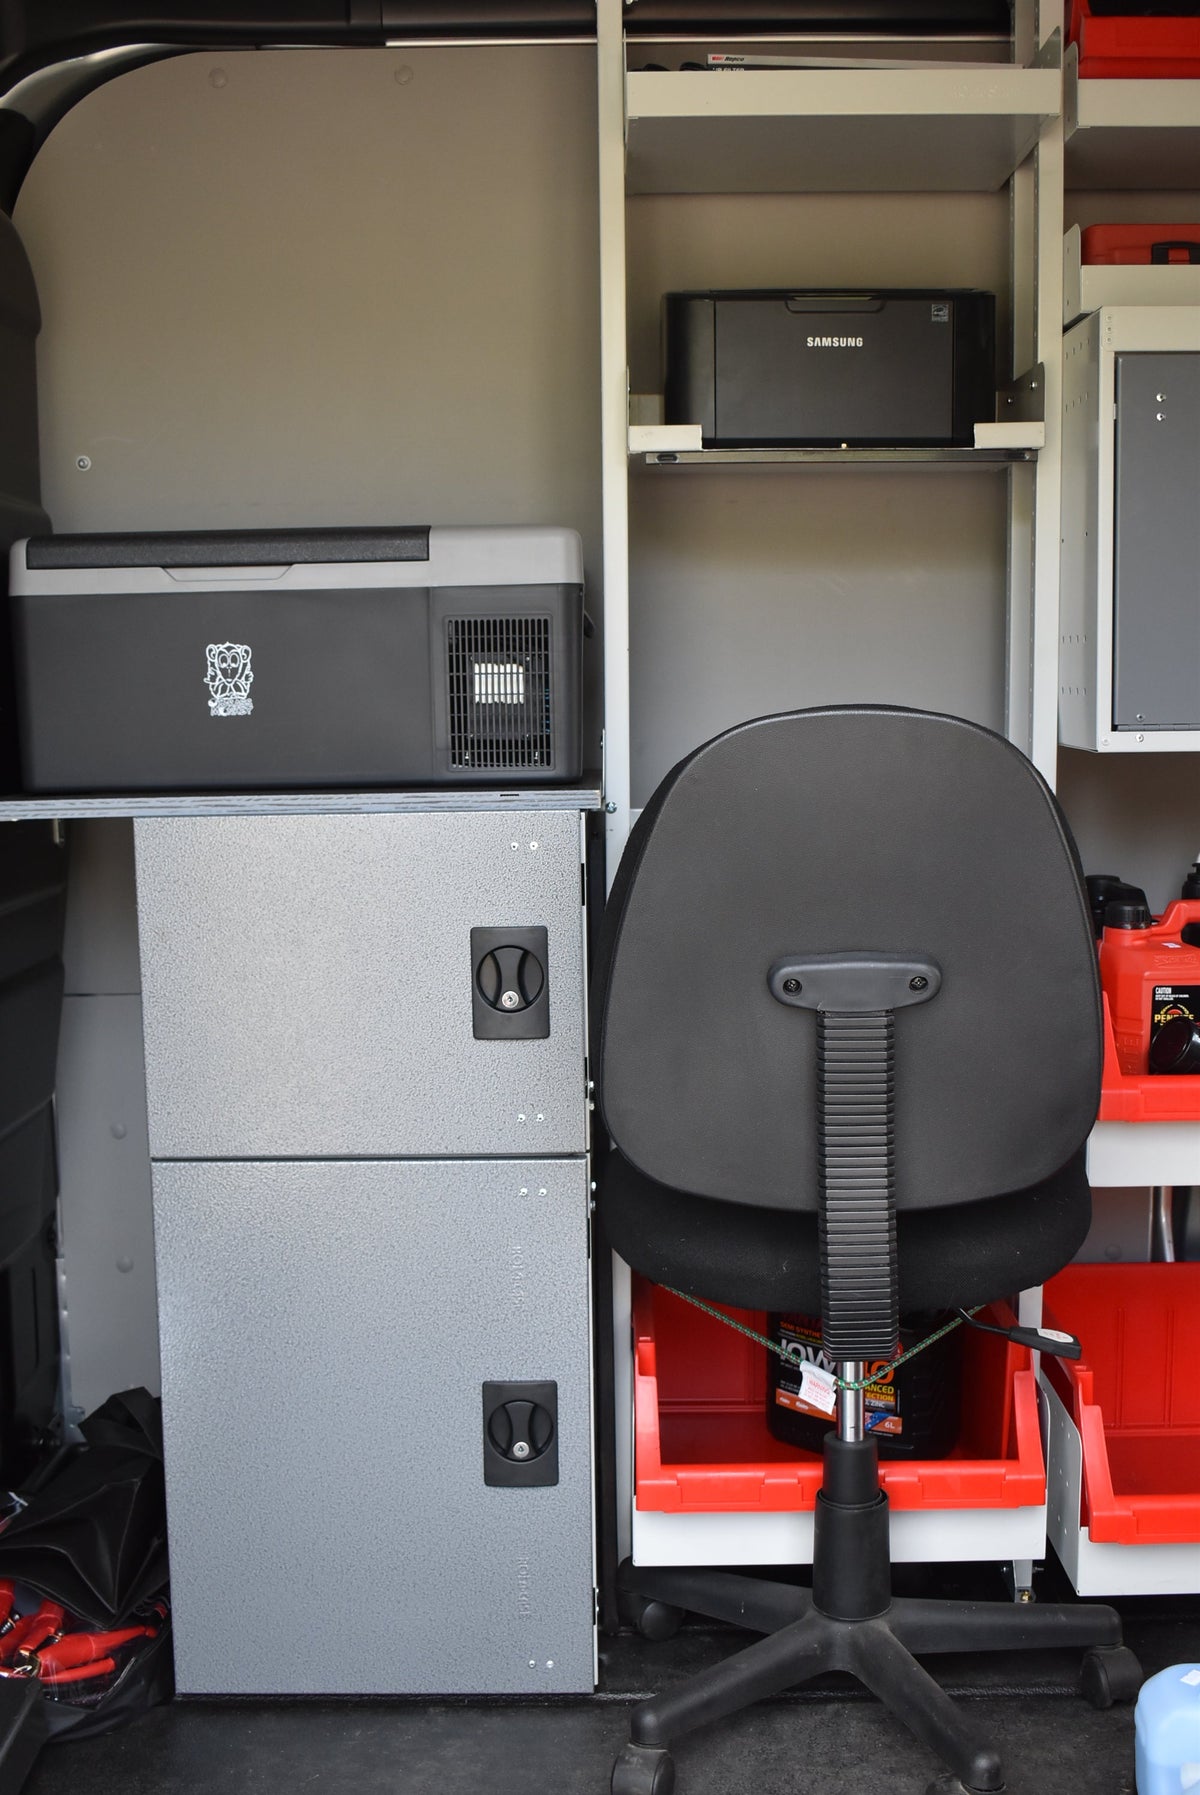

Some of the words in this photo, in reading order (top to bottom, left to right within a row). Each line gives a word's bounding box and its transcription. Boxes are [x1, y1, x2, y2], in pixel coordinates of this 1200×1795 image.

[806, 336, 863, 347] SAMSUNG
[1154, 1014, 1194, 1023] PENE
[796, 1326, 823, 1339] SYNTHE
[865, 1384, 895, 1394] ANCED
[865, 1392, 894, 1401] ECTION
[884, 1421, 895, 1429] 6L
